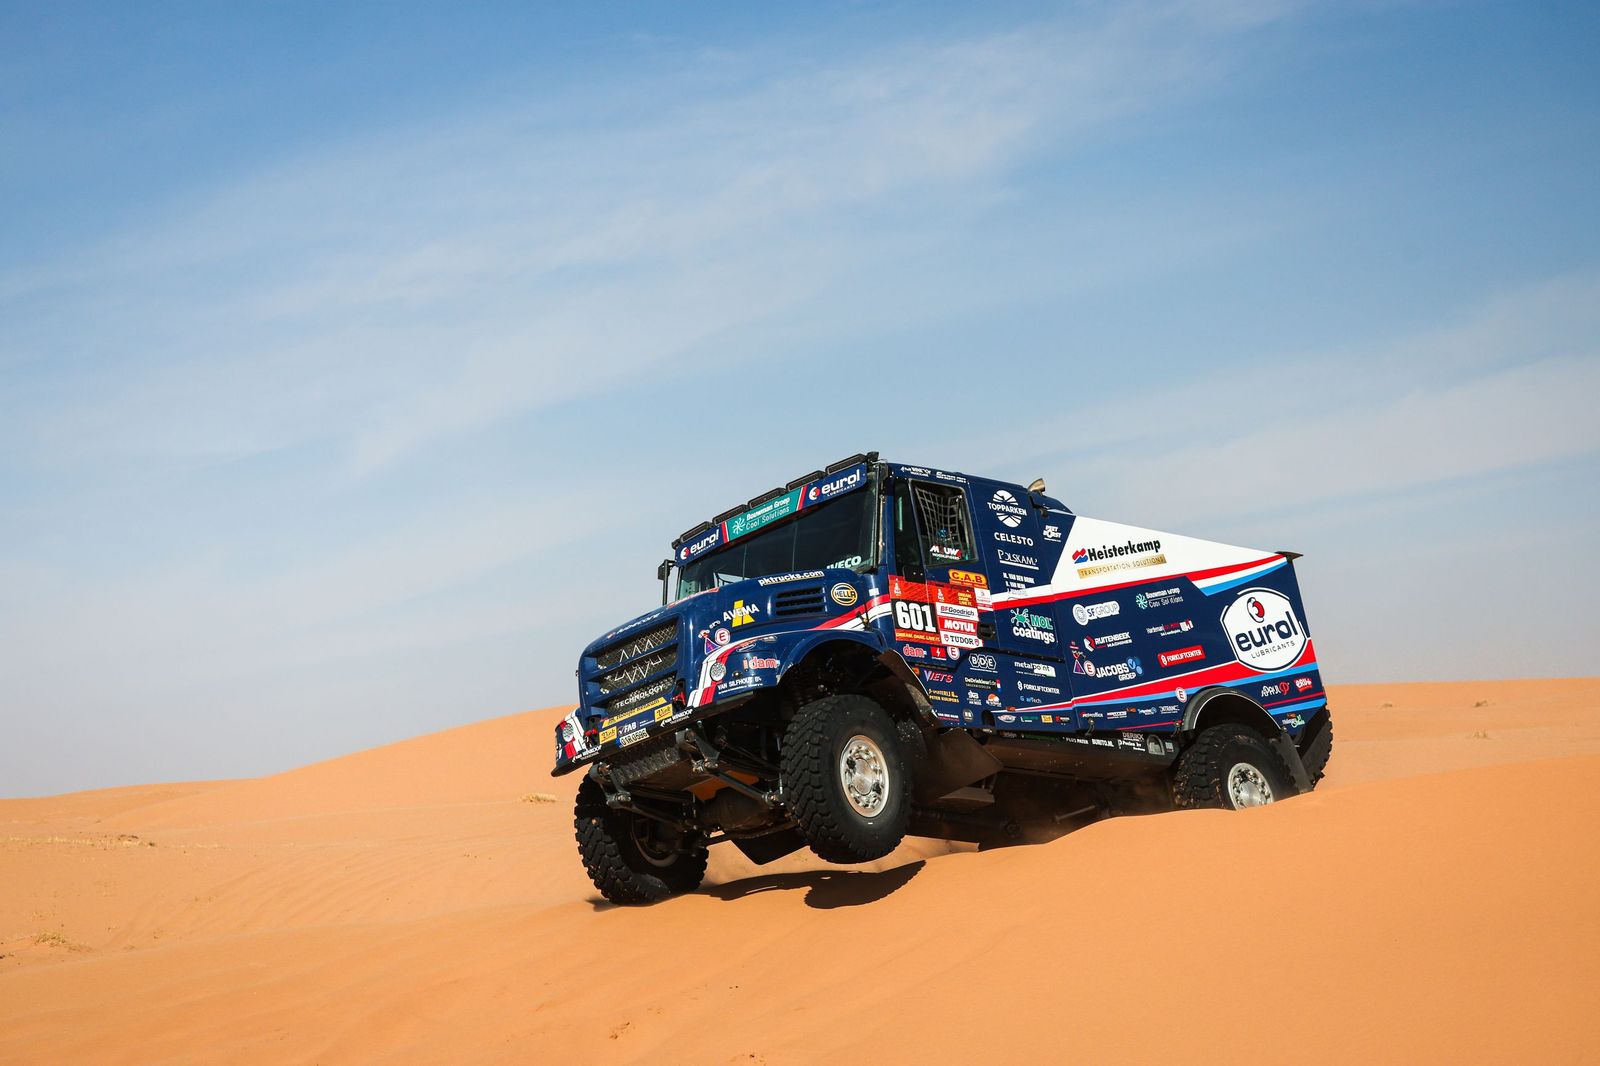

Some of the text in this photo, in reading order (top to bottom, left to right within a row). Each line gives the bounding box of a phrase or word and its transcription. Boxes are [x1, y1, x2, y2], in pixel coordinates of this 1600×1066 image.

[821, 469, 860, 494] eurol
[987, 502, 1027, 516] TOPPARKEN
[746, 518, 760, 530] Cool
[690, 530, 719, 553] eurol
[994, 532, 1034, 546] CELESTO
[1088, 540, 1161, 562] Heisterkamp
[827, 556, 861, 569] VECO
[1080, 556, 1164, 577] TRANSPORTATION SOLUTIONS
[758, 570, 824, 586] pktrucks.com
[834, 590, 856, 599] HELLA
[722, 604, 760, 622] AVEMA
[896, 602, 936, 632] 601
[940, 606, 974, 616] BFGoodrich
[944, 620, 975, 632] MOTUL
[1235, 611, 1298, 652] eurol
[950, 636, 974, 645] TUDOR
[1013, 626, 1055, 644] coatings
[1251, 640, 1296, 659] LUBRICANTS
[924, 670, 954, 683] VIETS
[1096, 663, 1130, 678] JACOBS
[616, 684, 664, 708] TECHNOLOGY
